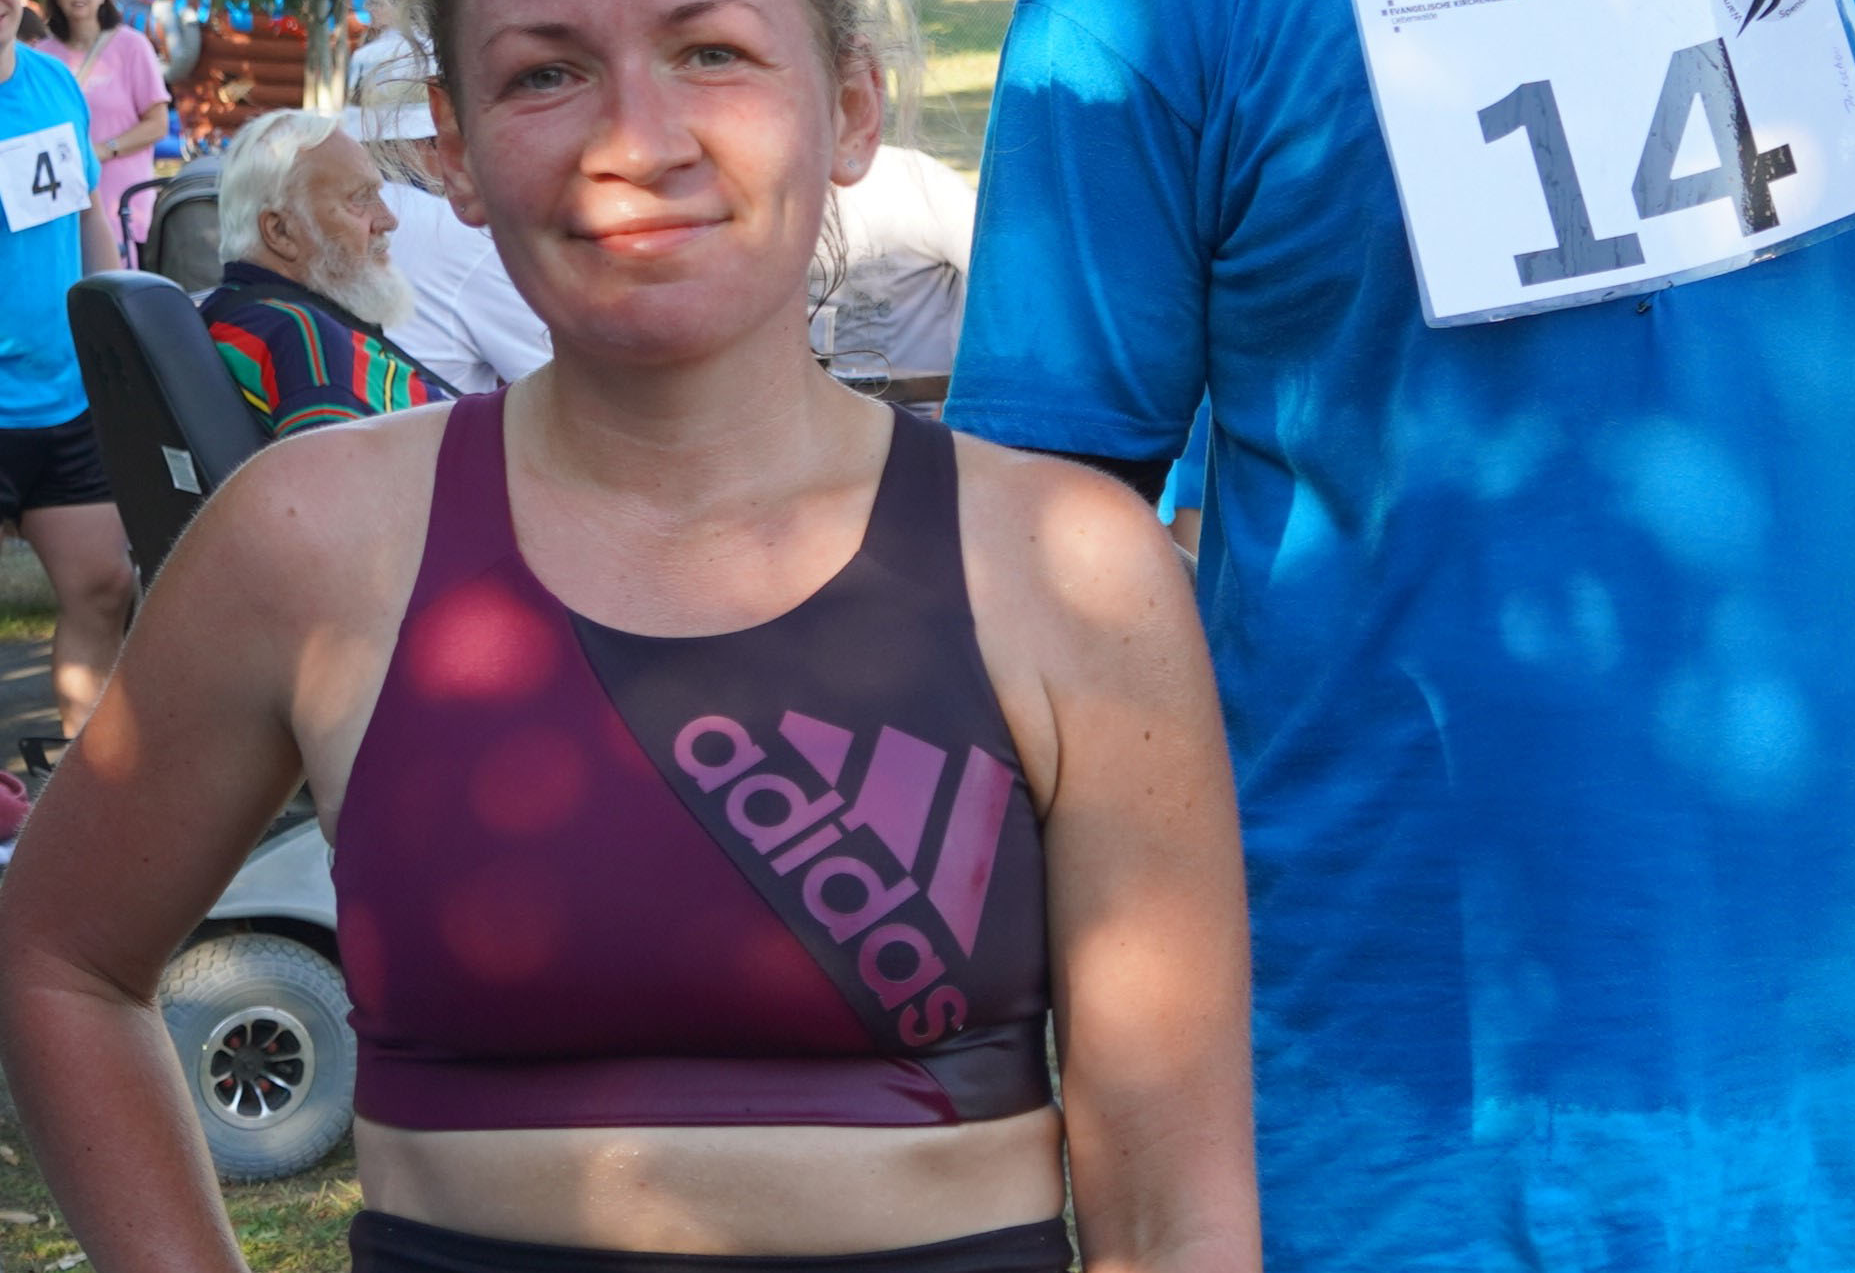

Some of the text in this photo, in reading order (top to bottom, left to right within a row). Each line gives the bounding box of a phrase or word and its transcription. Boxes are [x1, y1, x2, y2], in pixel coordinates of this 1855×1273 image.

[1389, 1, 1452, 16] EVANGELISCHE
[31, 151, 62, 201] 4
[1476, 36, 1798, 288] 14
[674, 715, 968, 1047] adidas
